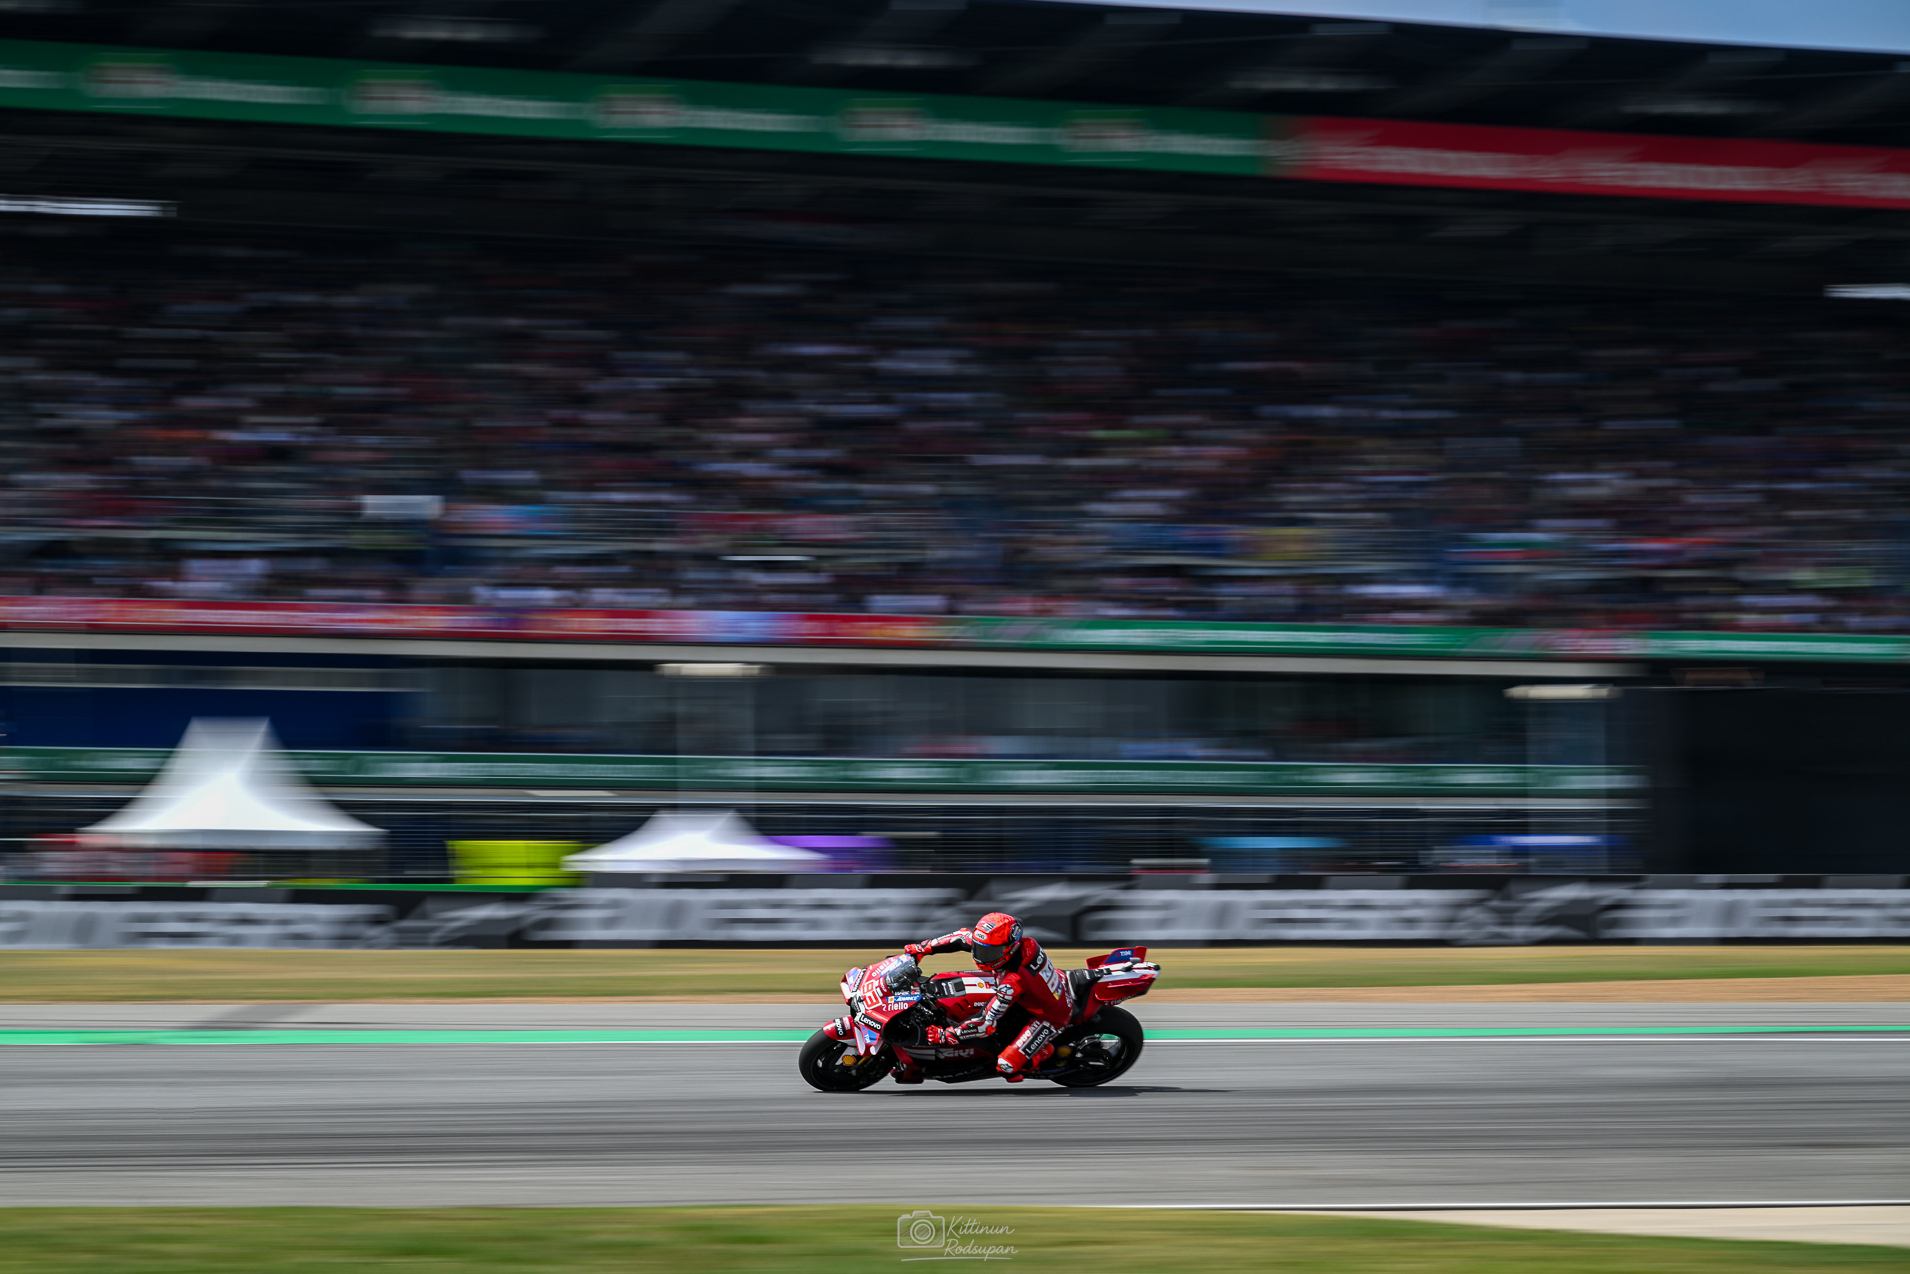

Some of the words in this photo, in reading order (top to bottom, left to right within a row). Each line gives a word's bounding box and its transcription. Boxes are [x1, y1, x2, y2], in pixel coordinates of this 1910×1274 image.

[862, 979, 883, 1009] 93
[888, 1002, 908, 1011] riello
[861, 1015, 881, 1029] Lenovo
[1016, 1020, 1040, 1047] DUCATI
[1026, 1029, 1049, 1054] Lenovo
